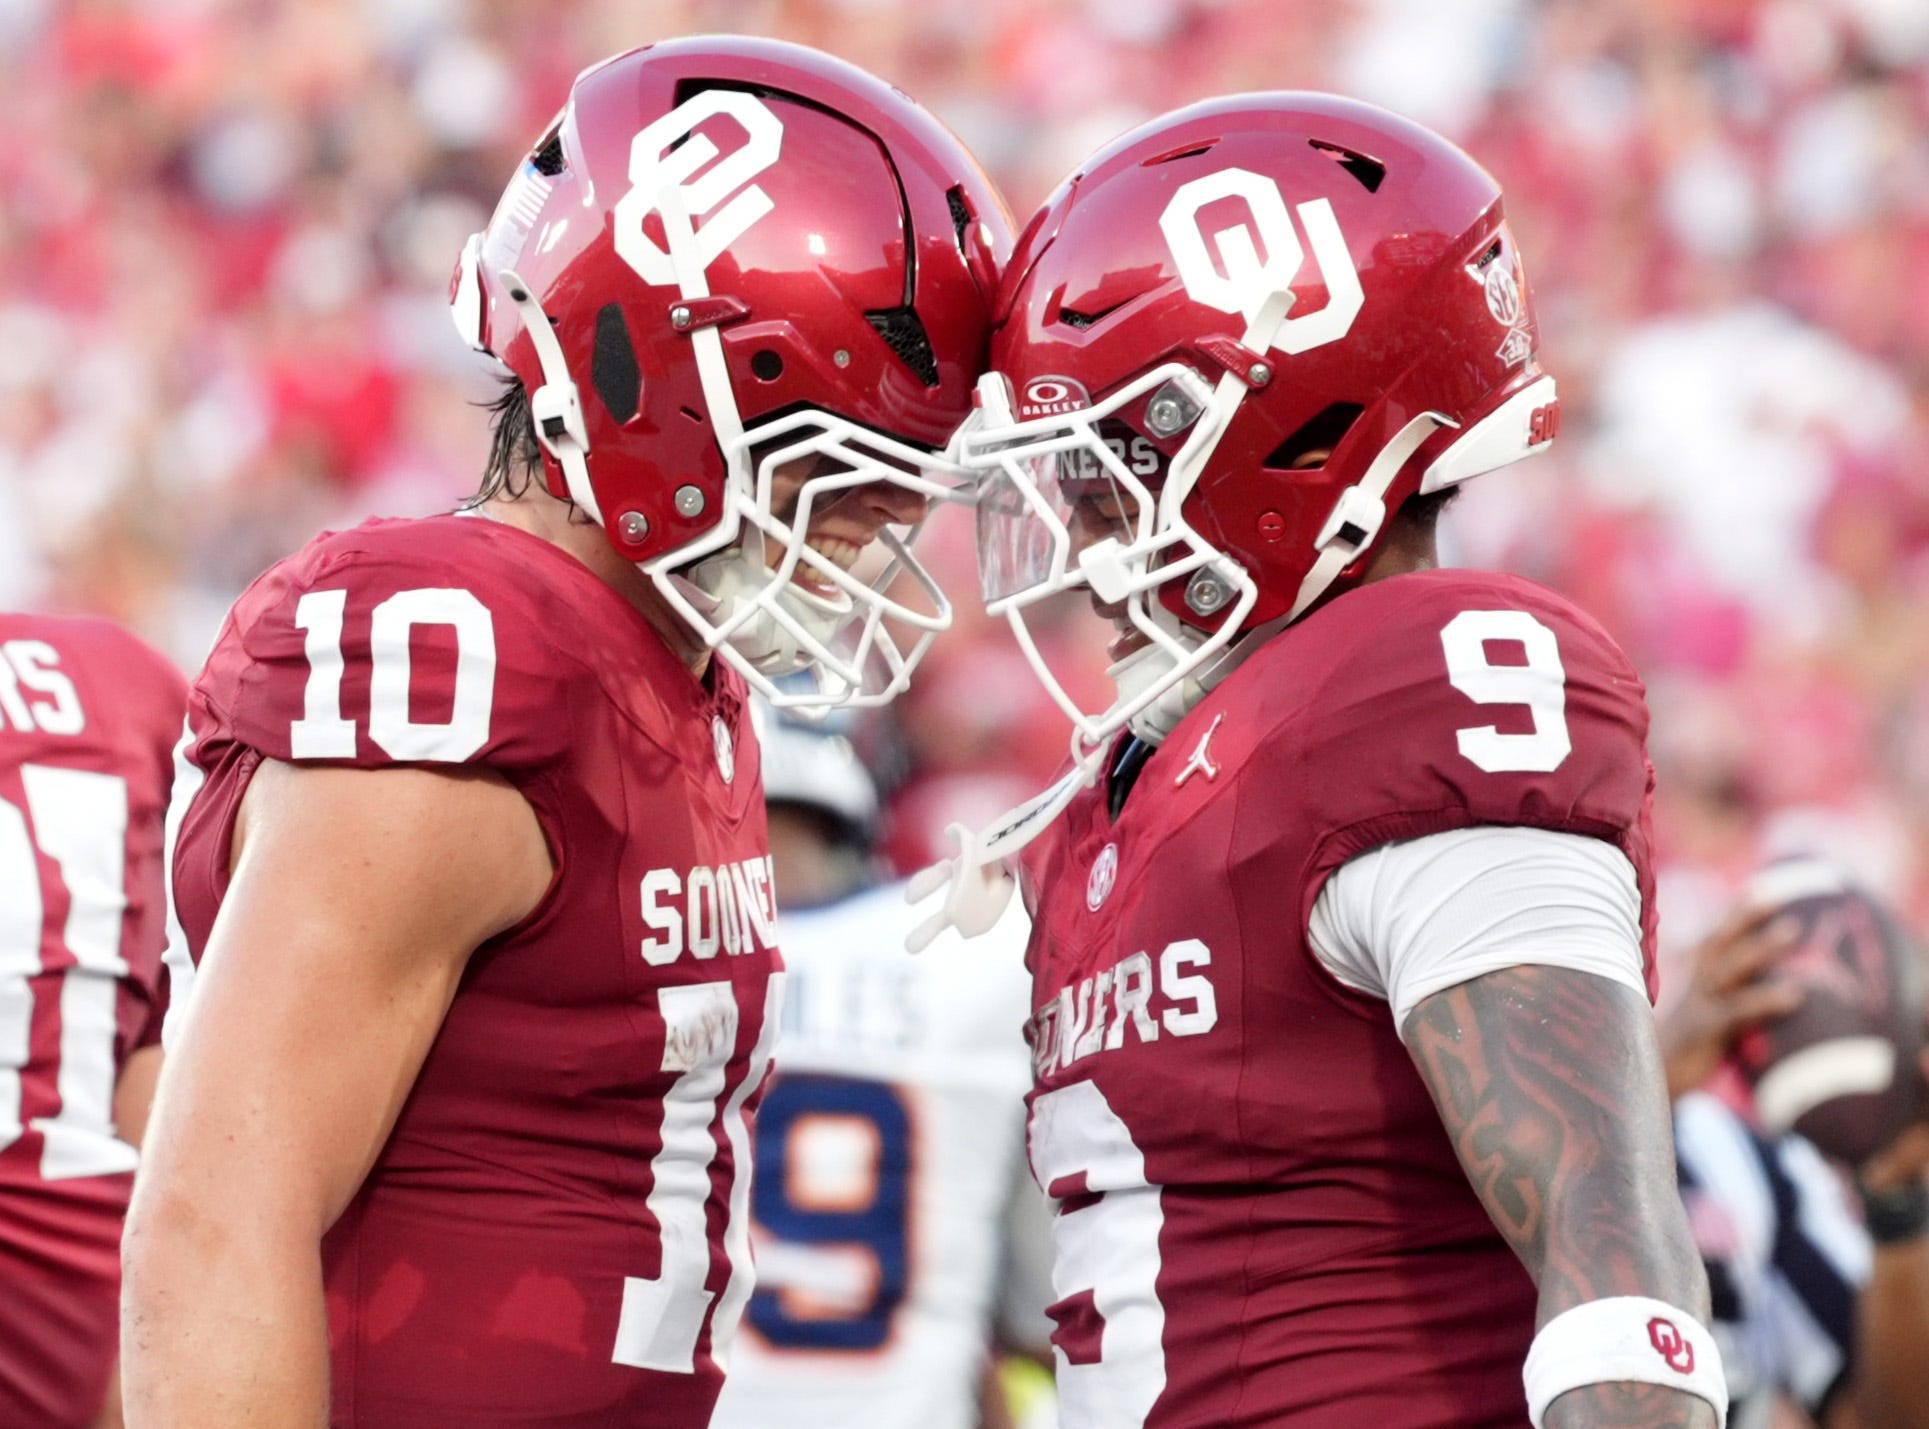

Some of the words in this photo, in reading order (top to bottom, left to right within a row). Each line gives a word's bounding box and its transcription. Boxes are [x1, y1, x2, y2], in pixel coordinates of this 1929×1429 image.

[614, 89, 785, 286] OU
[1158, 167, 1365, 354] OU
[1022, 400, 1083, 415] OAKLEY
[291, 588, 497, 763] 10
[1440, 610, 1573, 773] 9
[640, 853, 779, 967] SOONE
[1647, 1317, 1695, 1375] OU
